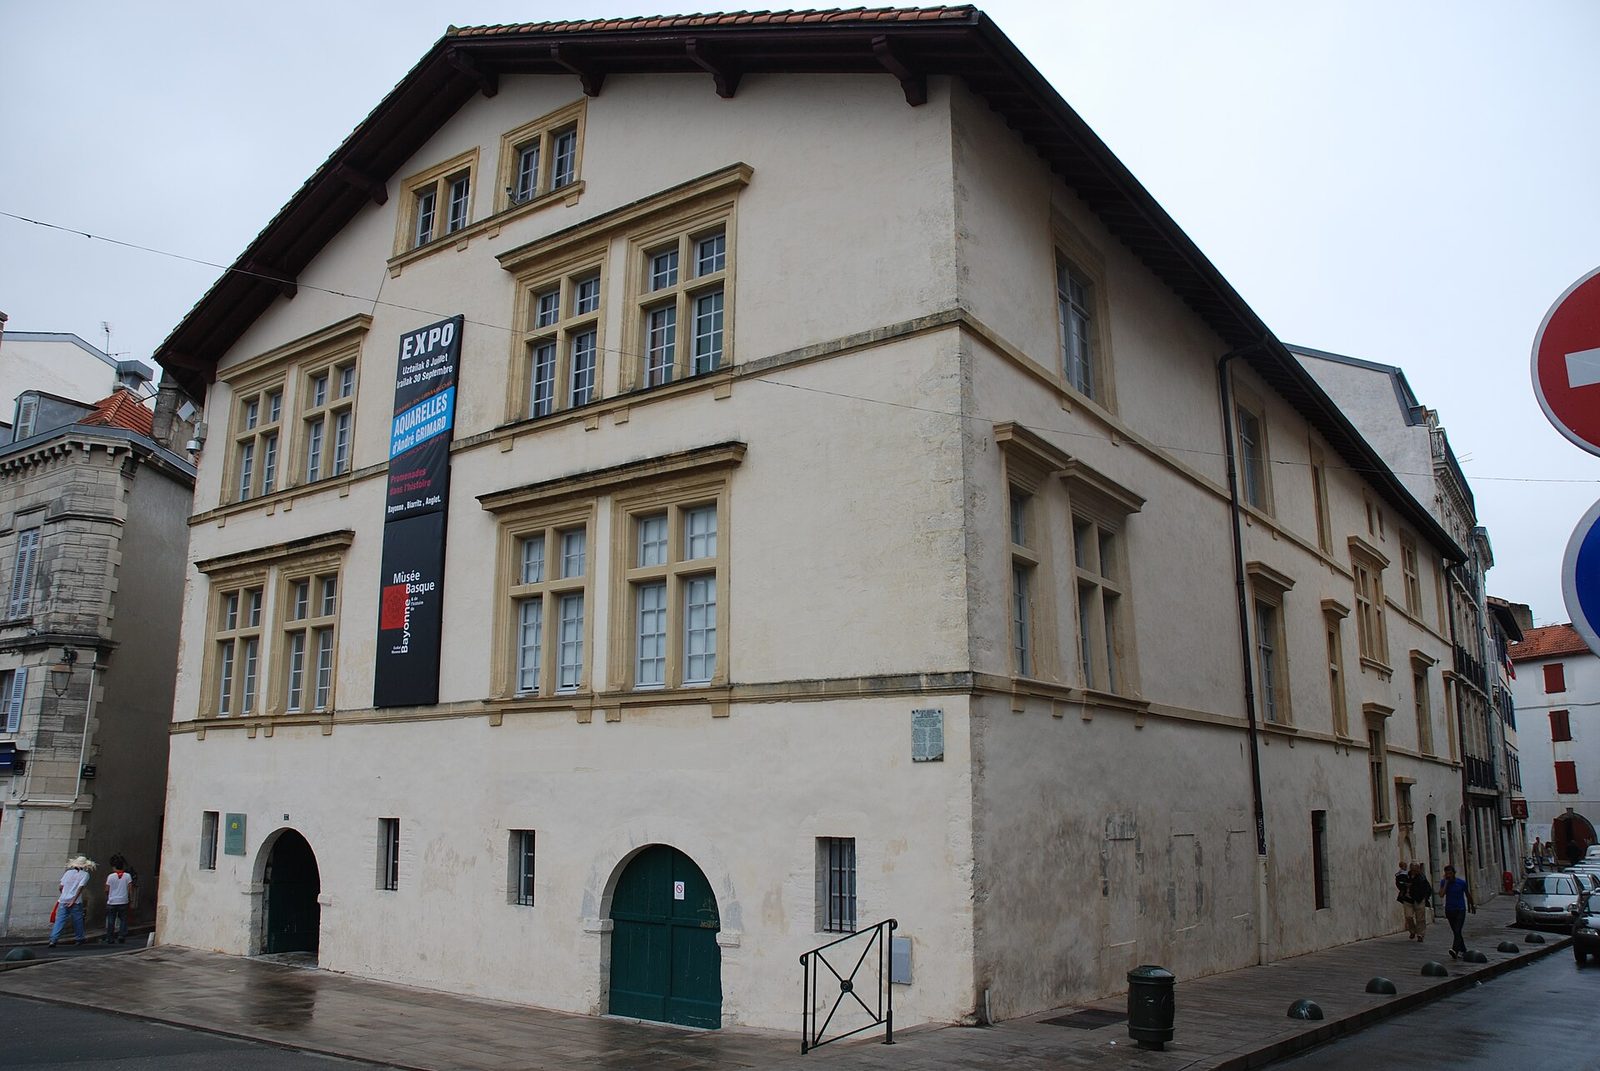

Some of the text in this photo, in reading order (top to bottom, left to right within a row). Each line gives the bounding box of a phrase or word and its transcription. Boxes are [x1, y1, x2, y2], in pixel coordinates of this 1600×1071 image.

[401, 322, 454, 360] EXPO
[421, 365, 453, 380] Septembre
[425, 359, 430, 368] 8
[430, 353, 448, 366] Juillet
[393, 393, 448, 438] AQUARELLES
[392, 432, 415, 455] d'André
[415, 415, 447, 442] GRIMARD
[405, 581, 435, 595] Basque
[400, 598, 411, 654] Bayonne
